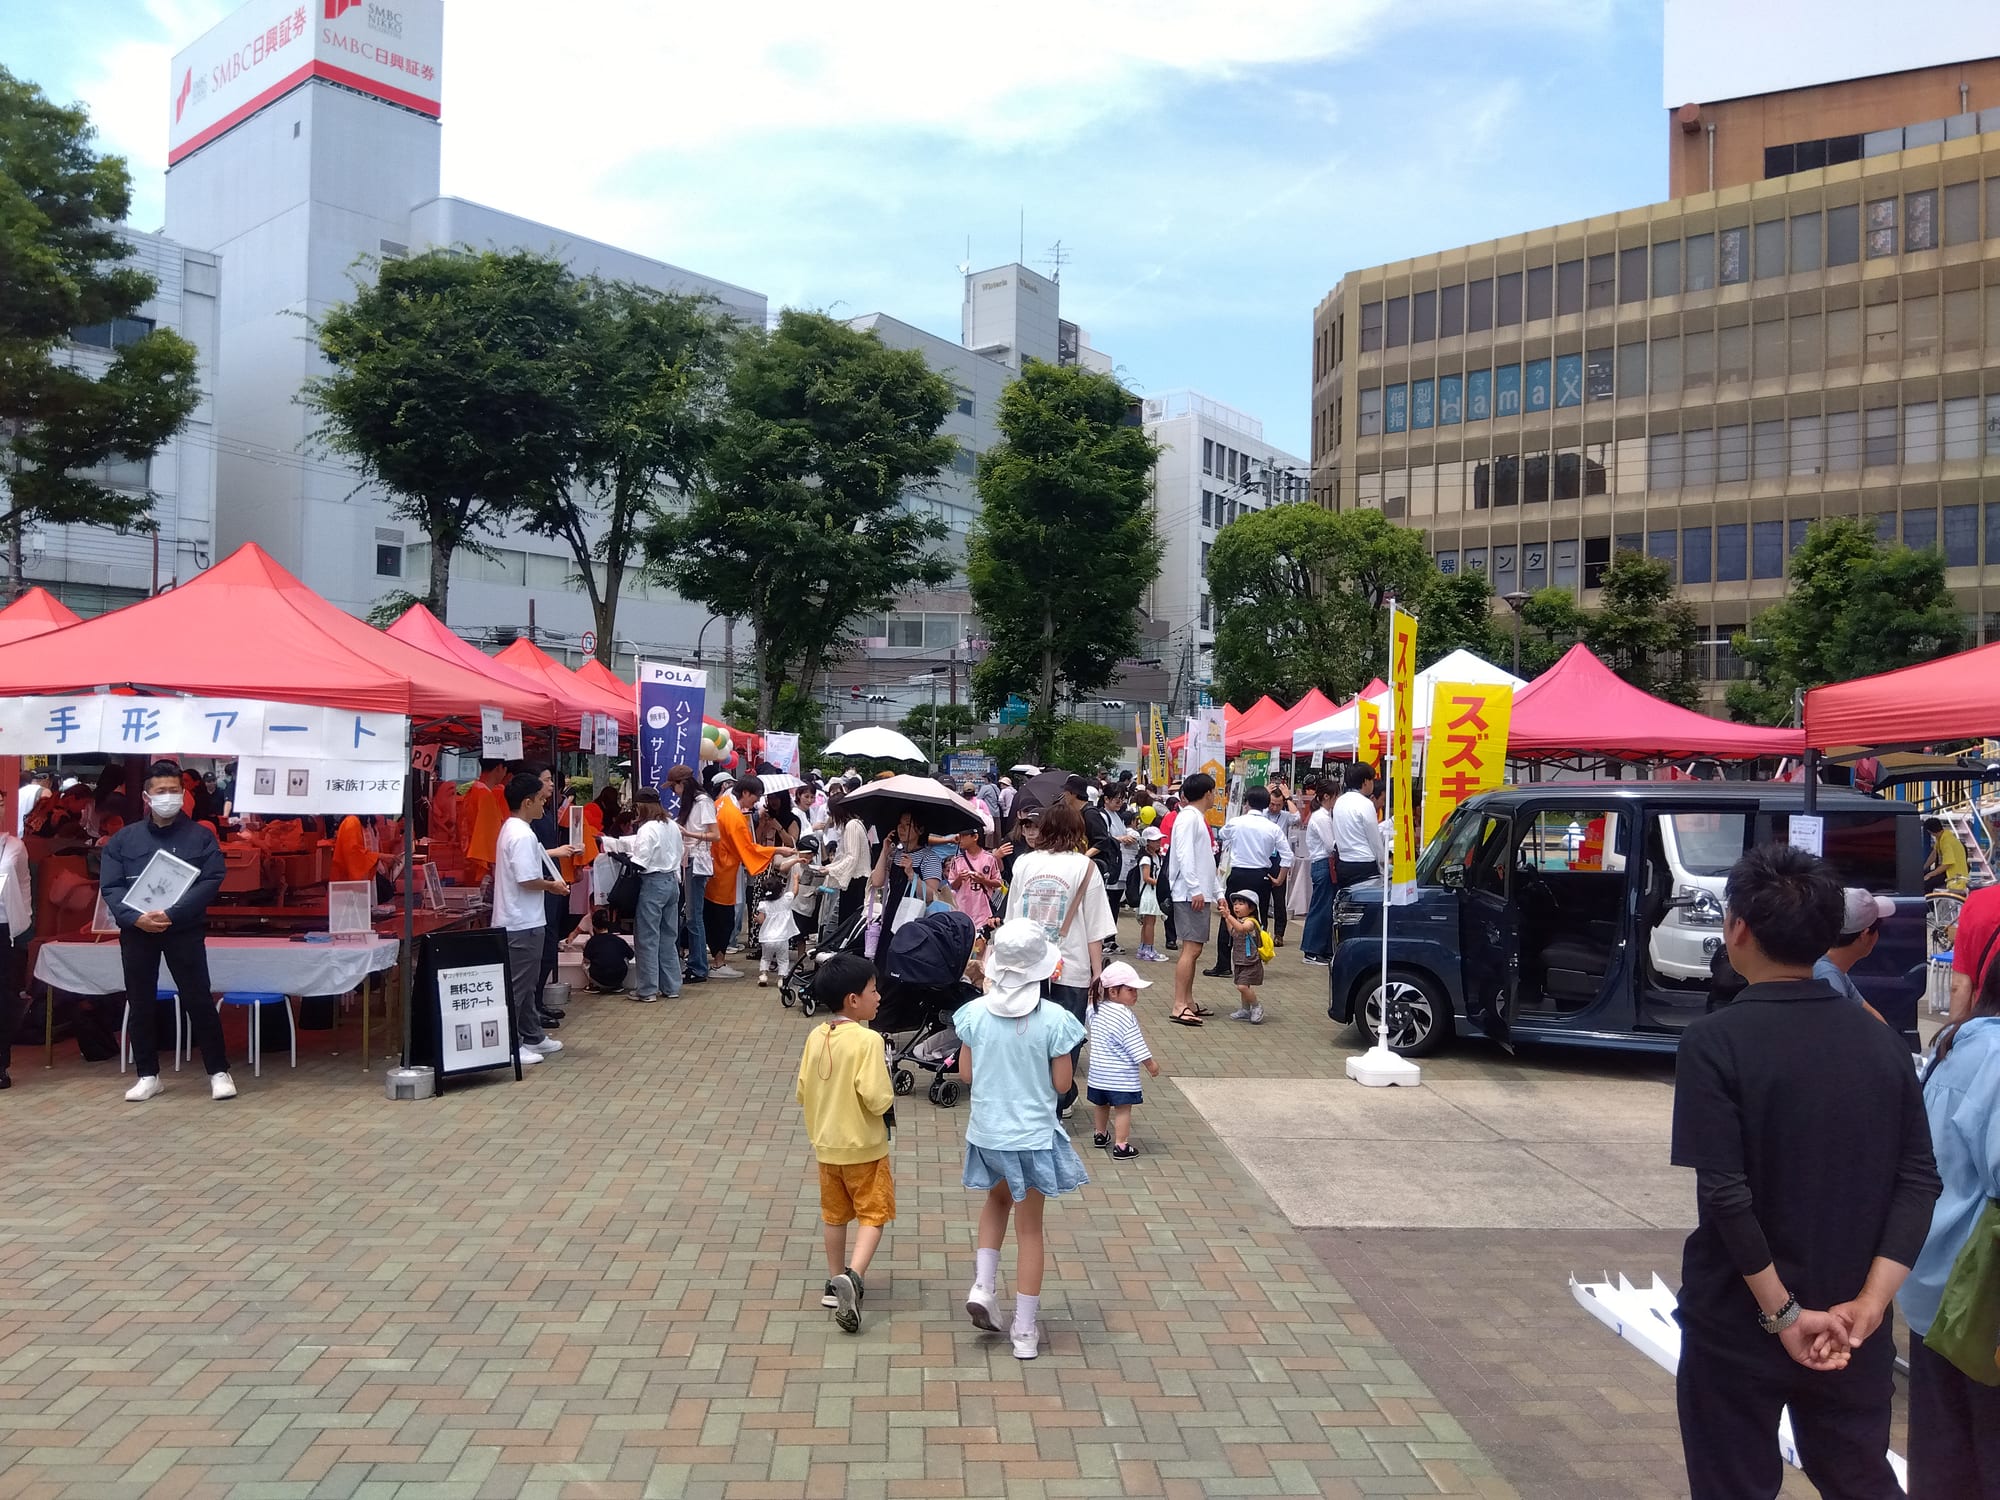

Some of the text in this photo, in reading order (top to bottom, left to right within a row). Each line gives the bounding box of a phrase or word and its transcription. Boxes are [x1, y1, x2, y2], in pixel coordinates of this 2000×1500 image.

[368, 3, 402, 25] SMBC
[368, 14, 402, 33] NIKKO
[211, 6, 307, 93] SMBC日興証券
[322, 28, 435, 81] SMBC日興証券
[655, 669, 692, 683] POLA
[650, 712, 667, 722] 無料
[44, 706, 376, 749] 手形アート
[650, 736, 665, 793] サービス
[325, 778, 401, 793] 1家族1つまで
[450, 981, 493, 995] 無料こども
[452, 996, 494, 1011] 手形アート
